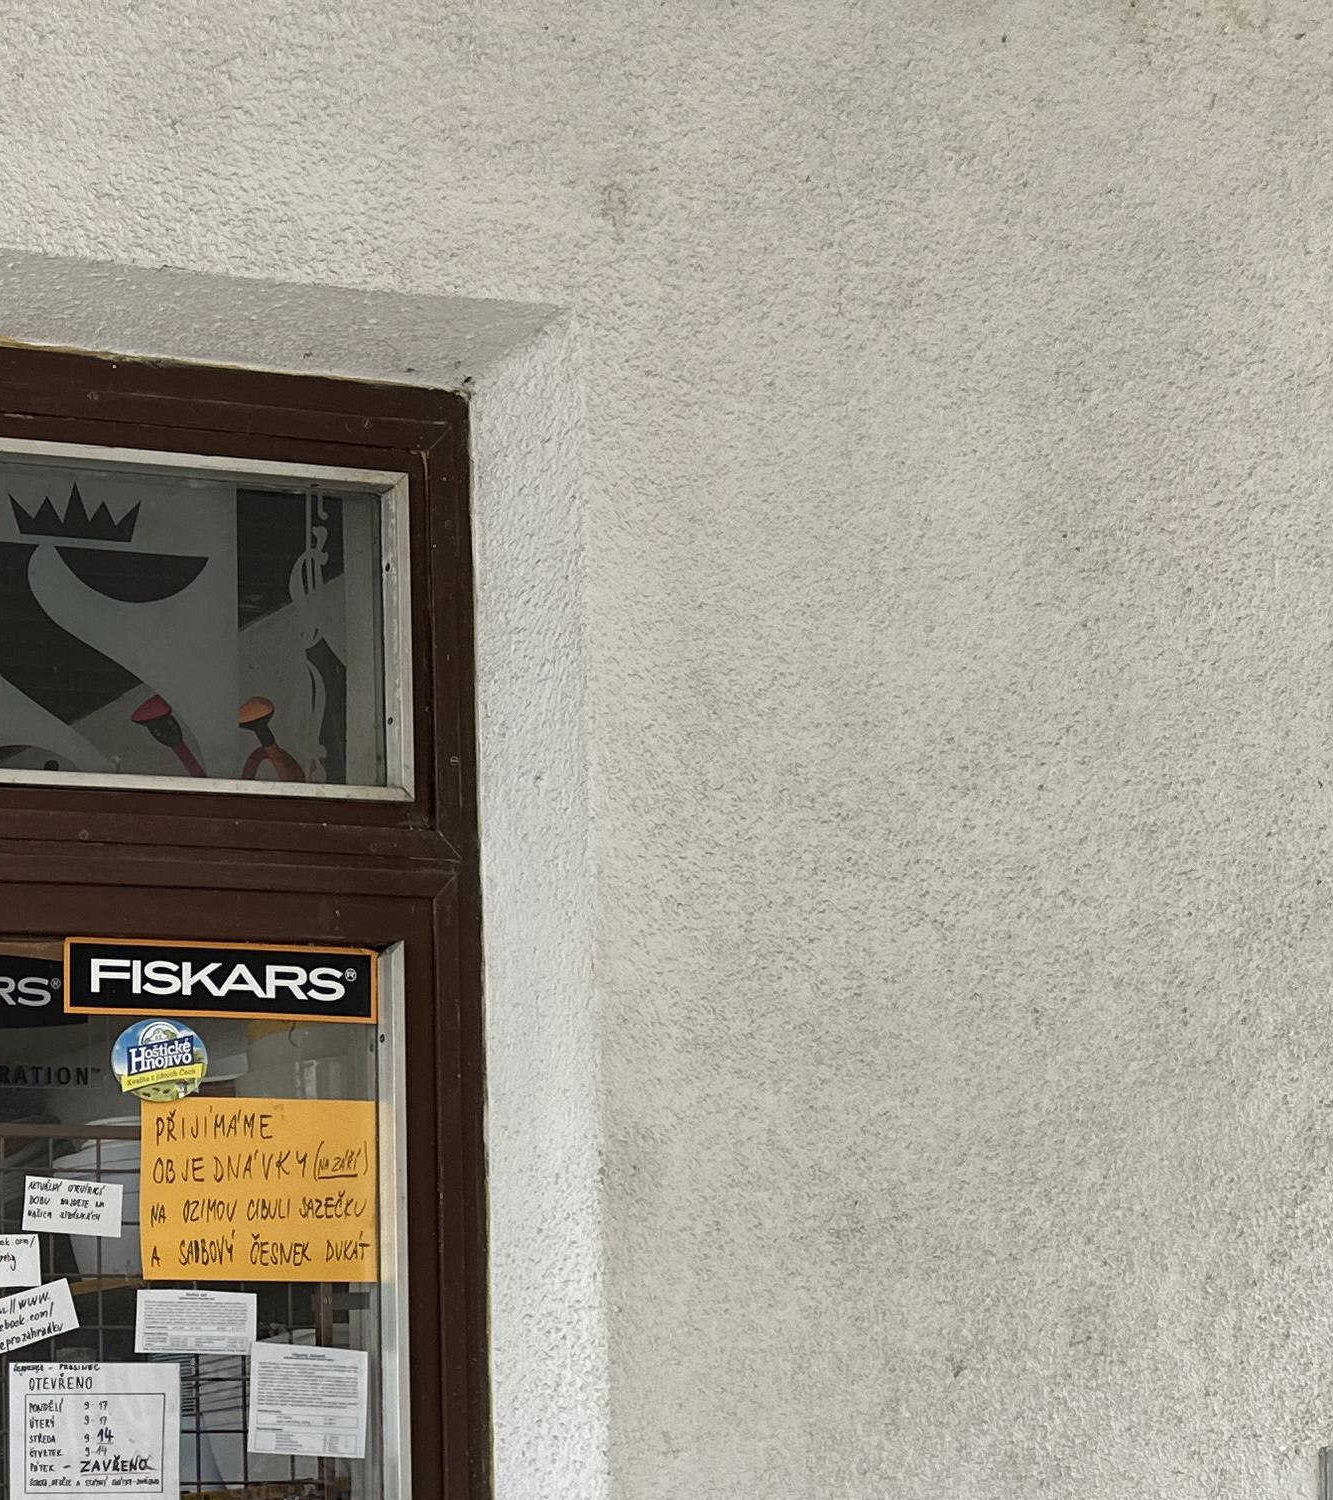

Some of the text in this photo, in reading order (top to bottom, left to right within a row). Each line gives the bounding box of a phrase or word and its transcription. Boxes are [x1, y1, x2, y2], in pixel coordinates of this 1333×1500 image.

[156, 1106, 273, 1146] PŘIJÍMÁME
[152, 1150, 308, 1185] OBJEDNÁVKY
[29, 1195, 51, 1205] DOBU
[150, 1190, 367, 1228] NA OZIMOU CIBULI SAZEČKU
[151, 1229, 371, 1267] A SADBOVÝ ČESNEK DUKÁT
[29, 1373, 93, 1391] OTEVŘENO
[29, 1398, 64, 1413] PONDĚLÍ
[29, 1433, 56, 1444] STŘEDA
[80, 1455, 154, 1473] ZAVŘENO
